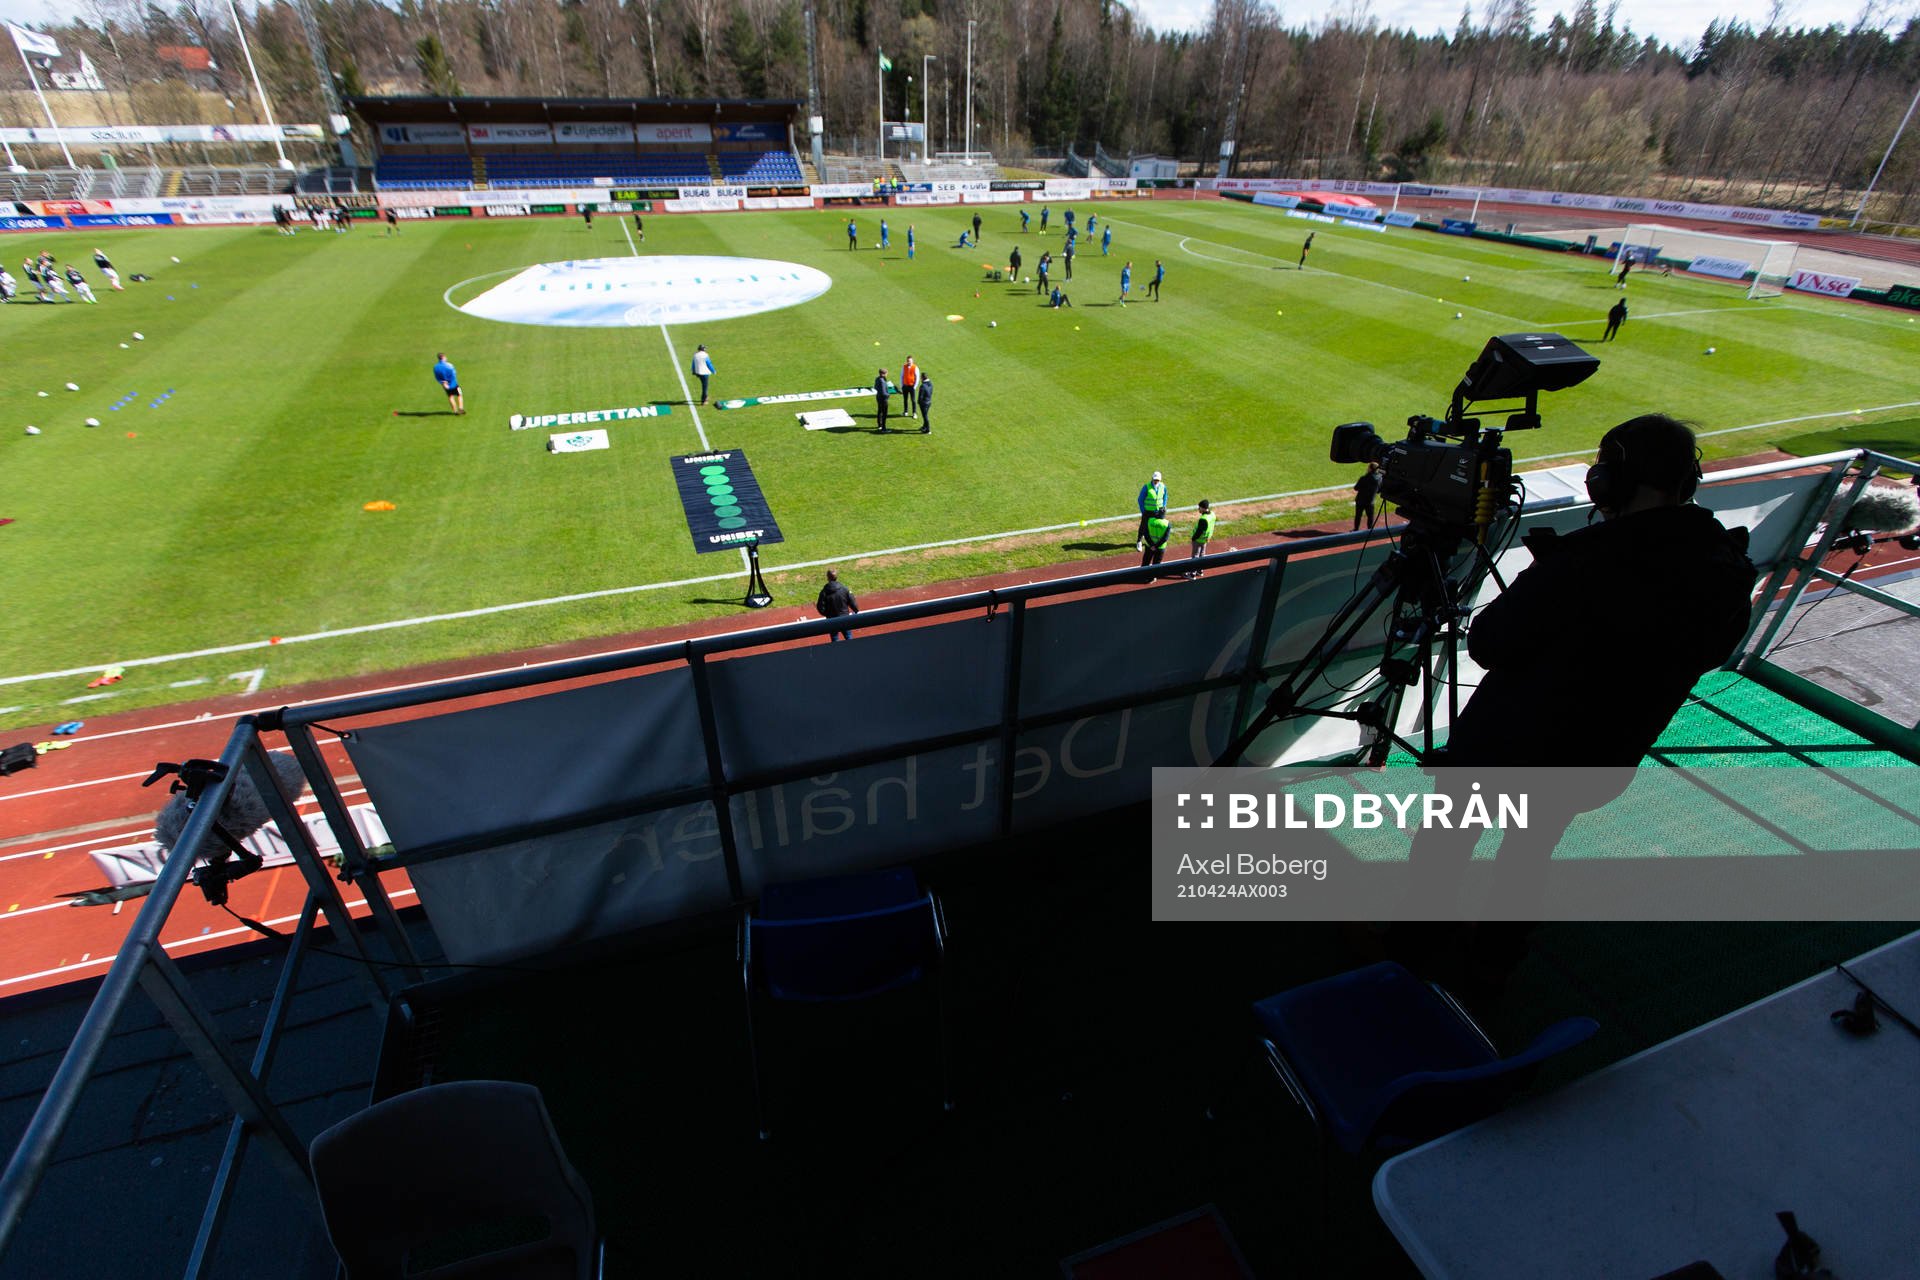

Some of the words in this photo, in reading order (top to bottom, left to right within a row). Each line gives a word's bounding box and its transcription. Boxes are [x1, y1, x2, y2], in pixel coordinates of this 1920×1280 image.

[1796, 272, 1851, 293] VN.se
[684, 453, 731, 464] UNIBET
[709, 529, 764, 543] UNIBET
